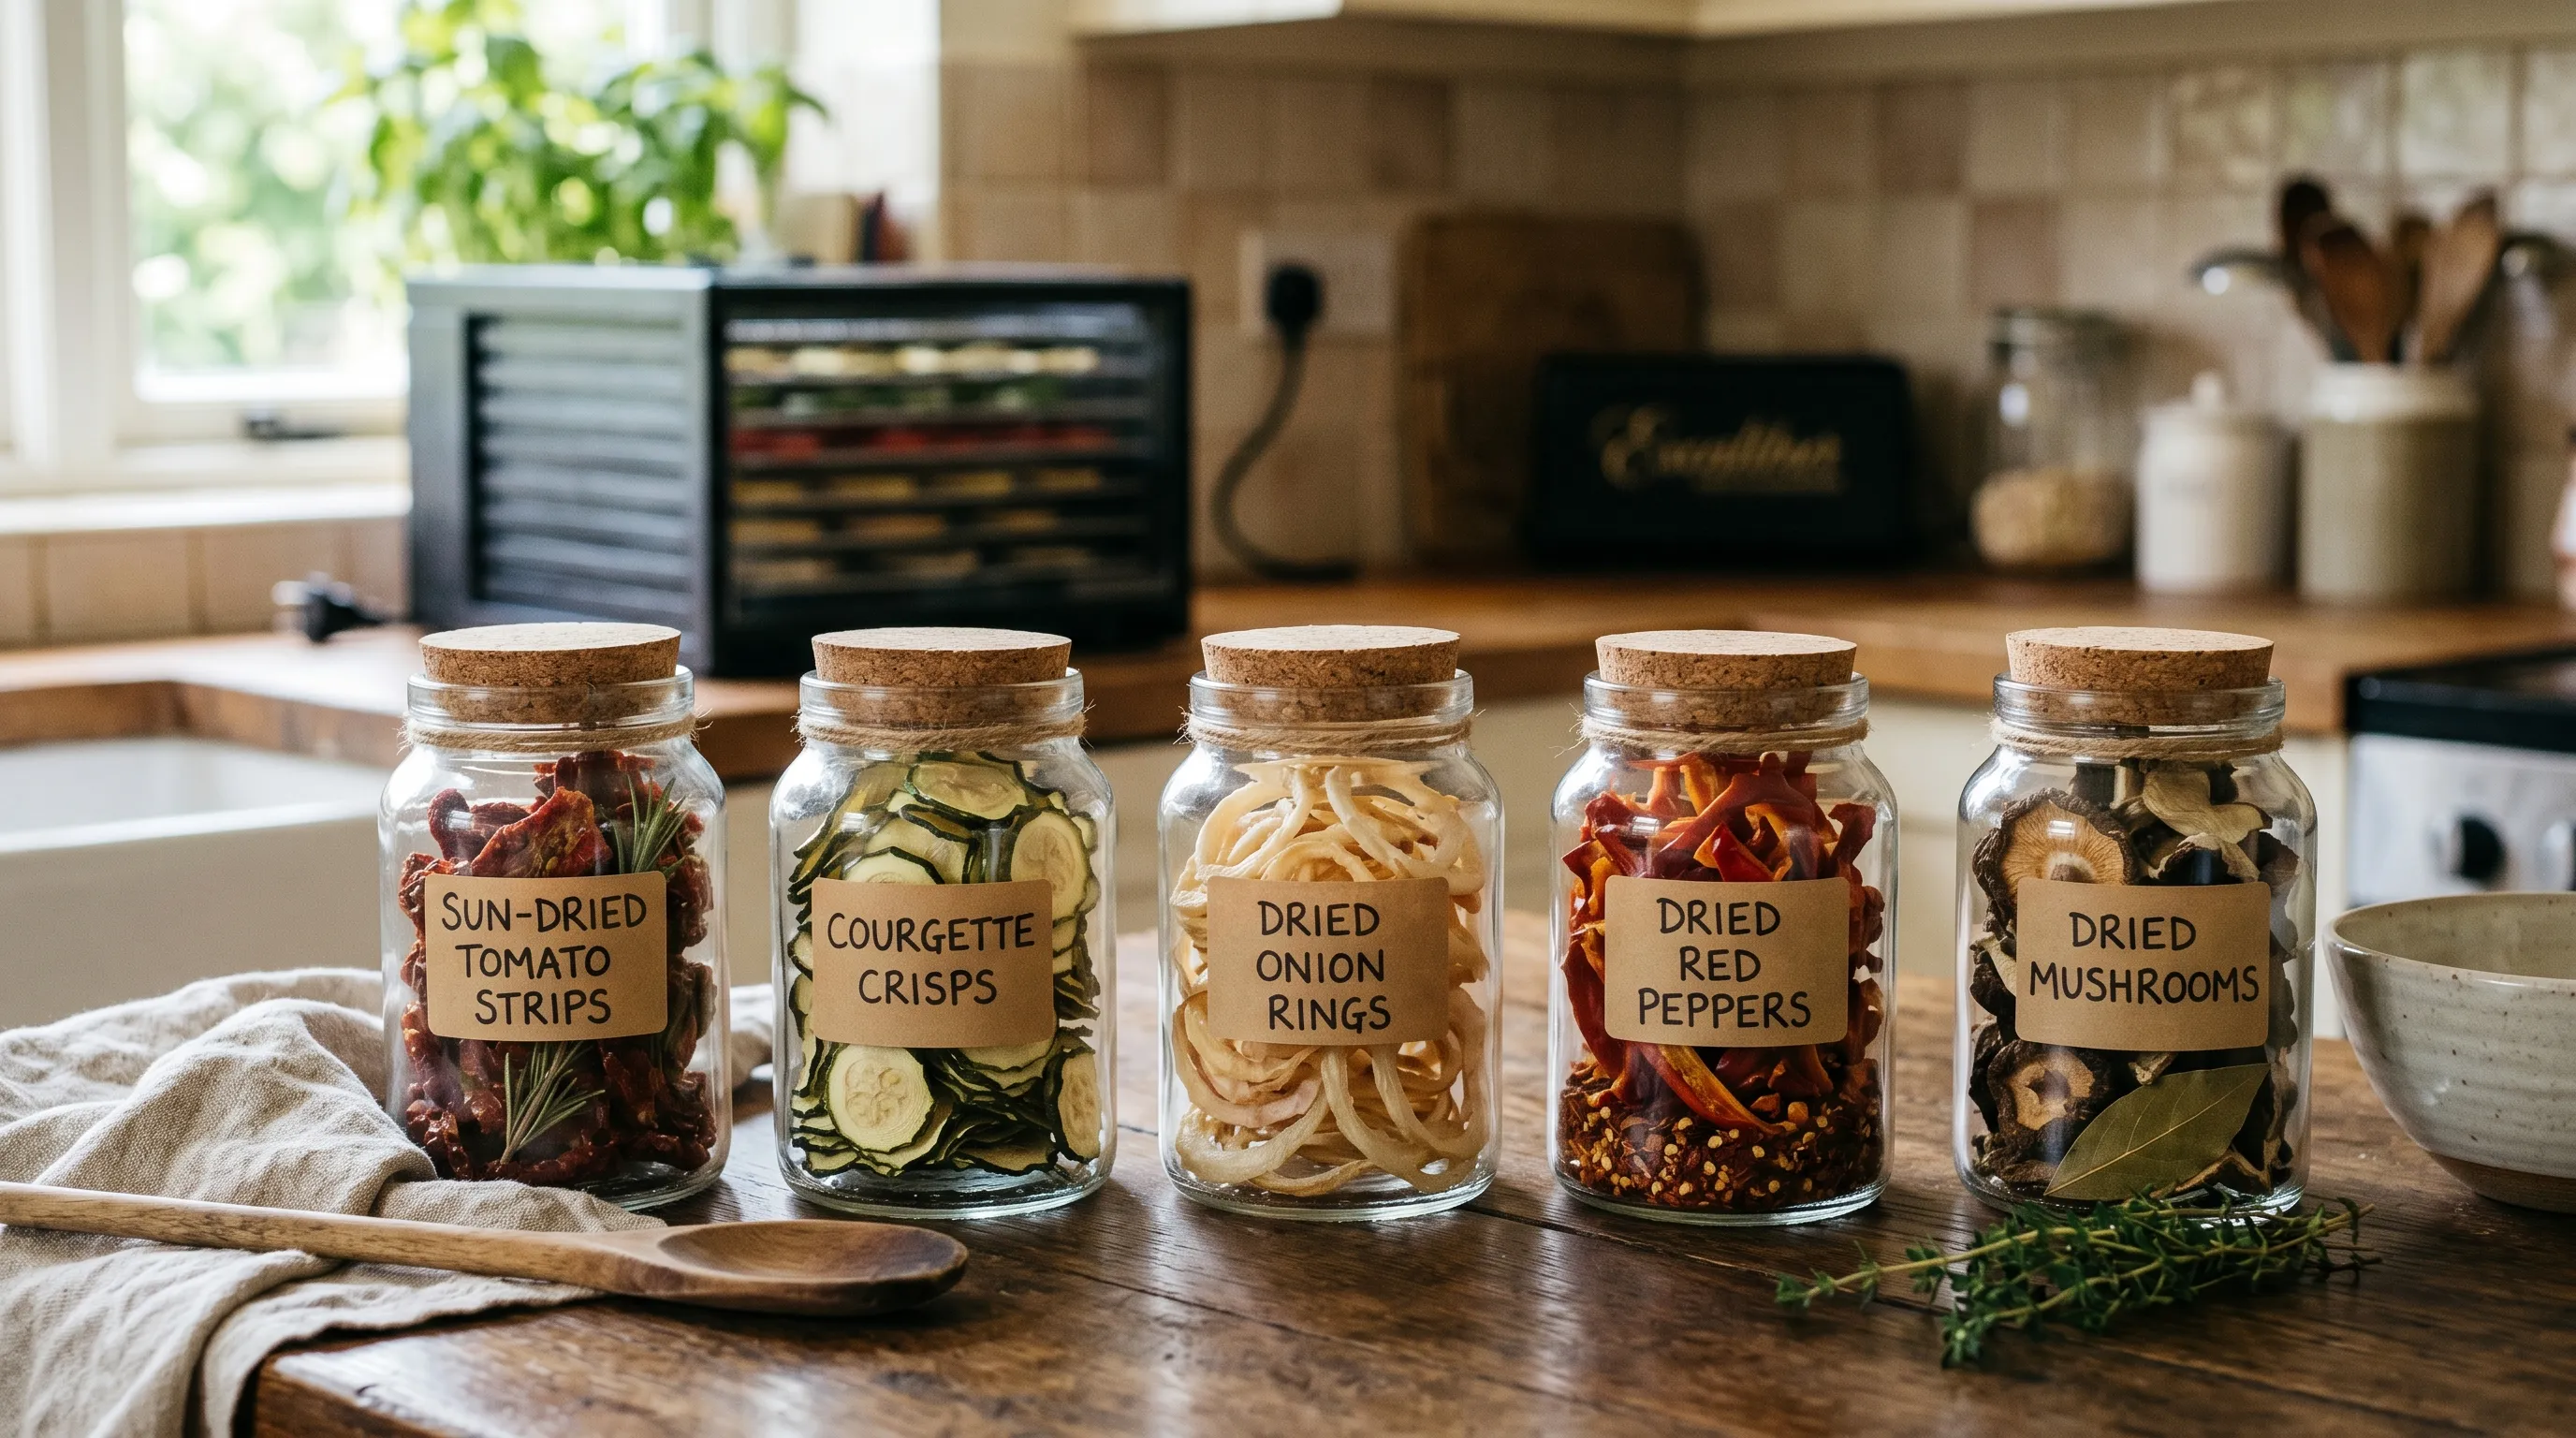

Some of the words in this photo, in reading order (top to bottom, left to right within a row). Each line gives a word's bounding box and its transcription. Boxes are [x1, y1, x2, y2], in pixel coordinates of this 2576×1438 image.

[442, 891, 647, 932] SUN-DRIED
[1257, 900, 1380, 937] DRIED
[1656, 897, 1781, 936] DRIED
[2069, 911, 2197, 951] DRIED
[827, 912, 1035, 955] COURGETTE
[455, 943, 611, 979] TOMATO
[1256, 947, 1385, 984] ONION
[1679, 945, 1762, 983] RED
[858, 969, 998, 1006] CRISPS
[2029, 961, 2260, 1005] MUSHROOMS
[475, 988, 612, 1025] STRIPS
[1268, 993, 1391, 1034] RINGS
[1638, 987, 1811, 1029] PEPPERS
